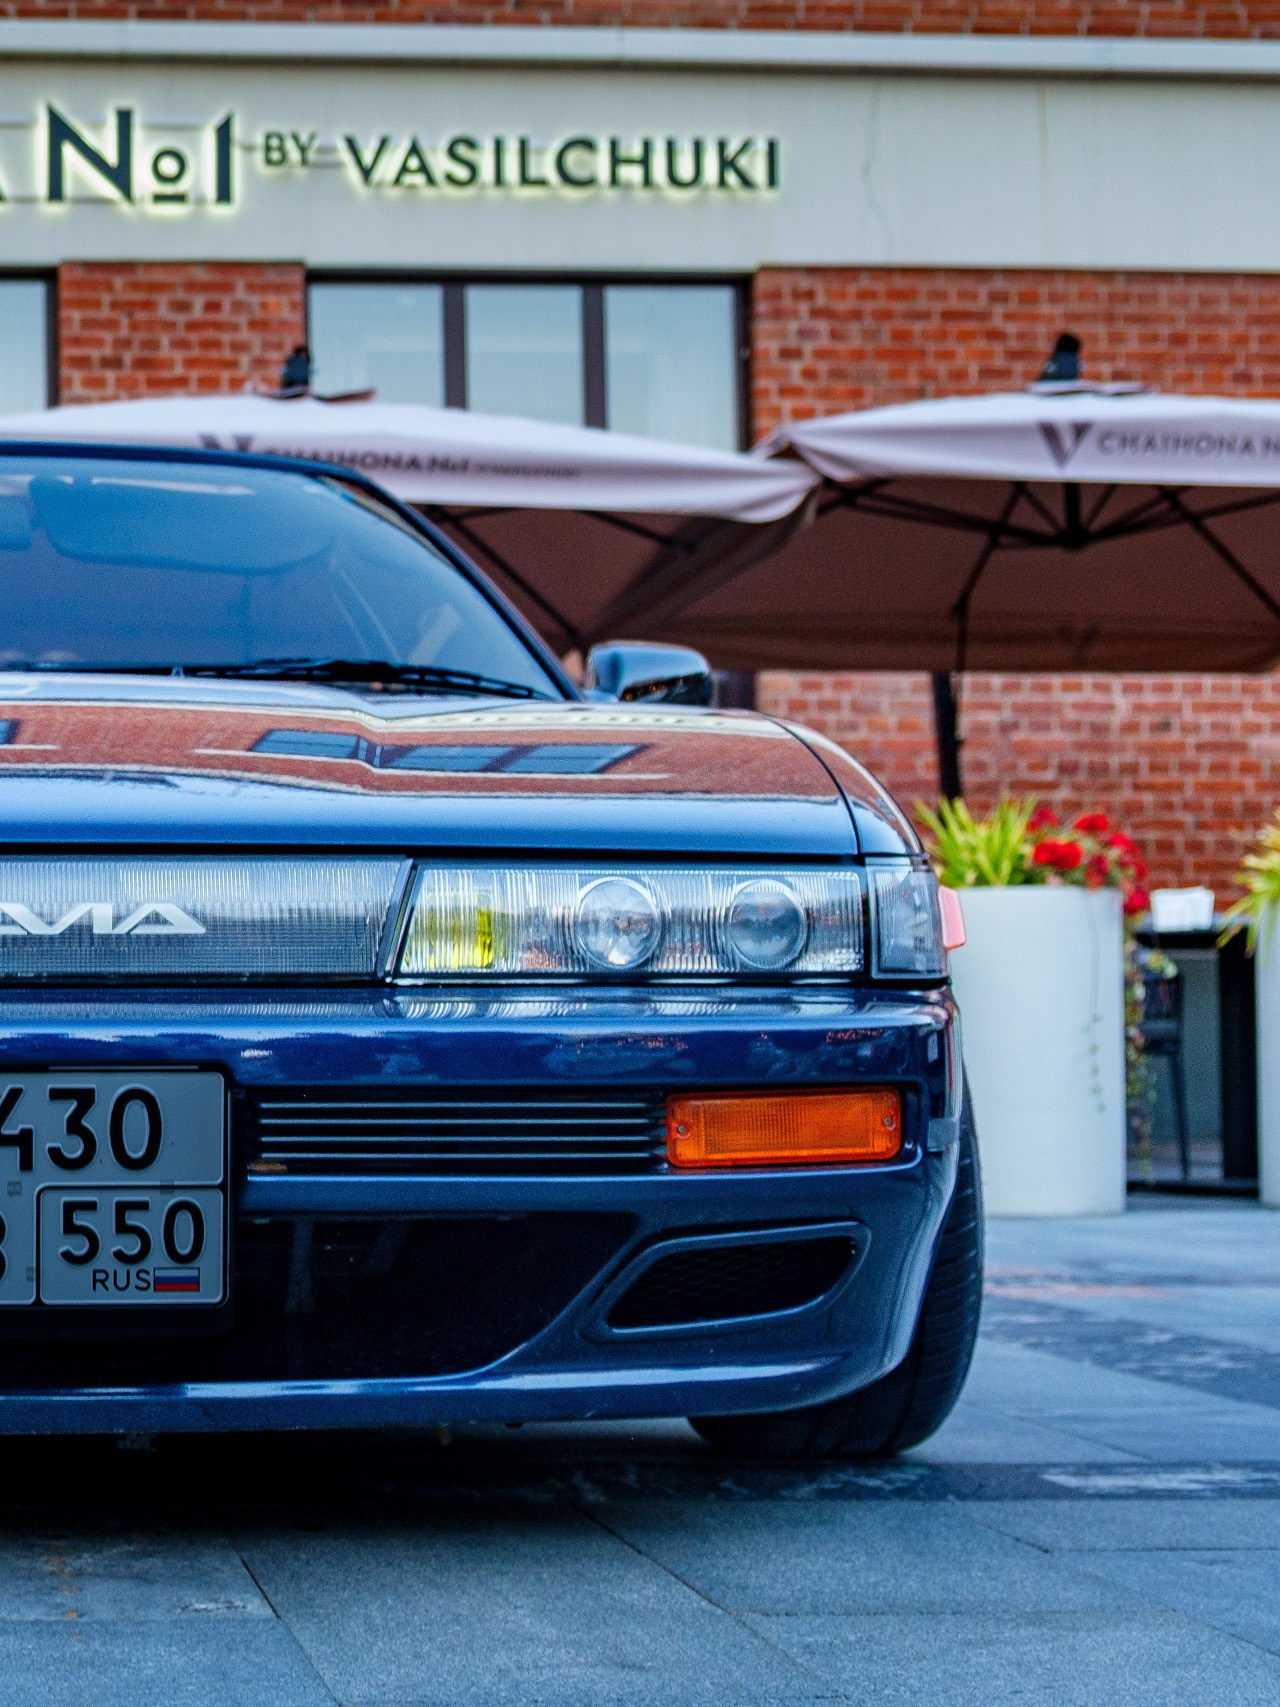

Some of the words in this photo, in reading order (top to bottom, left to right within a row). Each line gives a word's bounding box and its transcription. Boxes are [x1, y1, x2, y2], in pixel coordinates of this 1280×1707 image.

[263, 131, 316, 168] BY
[344, 135, 780, 192] VASILCHUKI
[58, 1197, 206, 1266] 550
[91, 1268, 152, 1292] RUS
